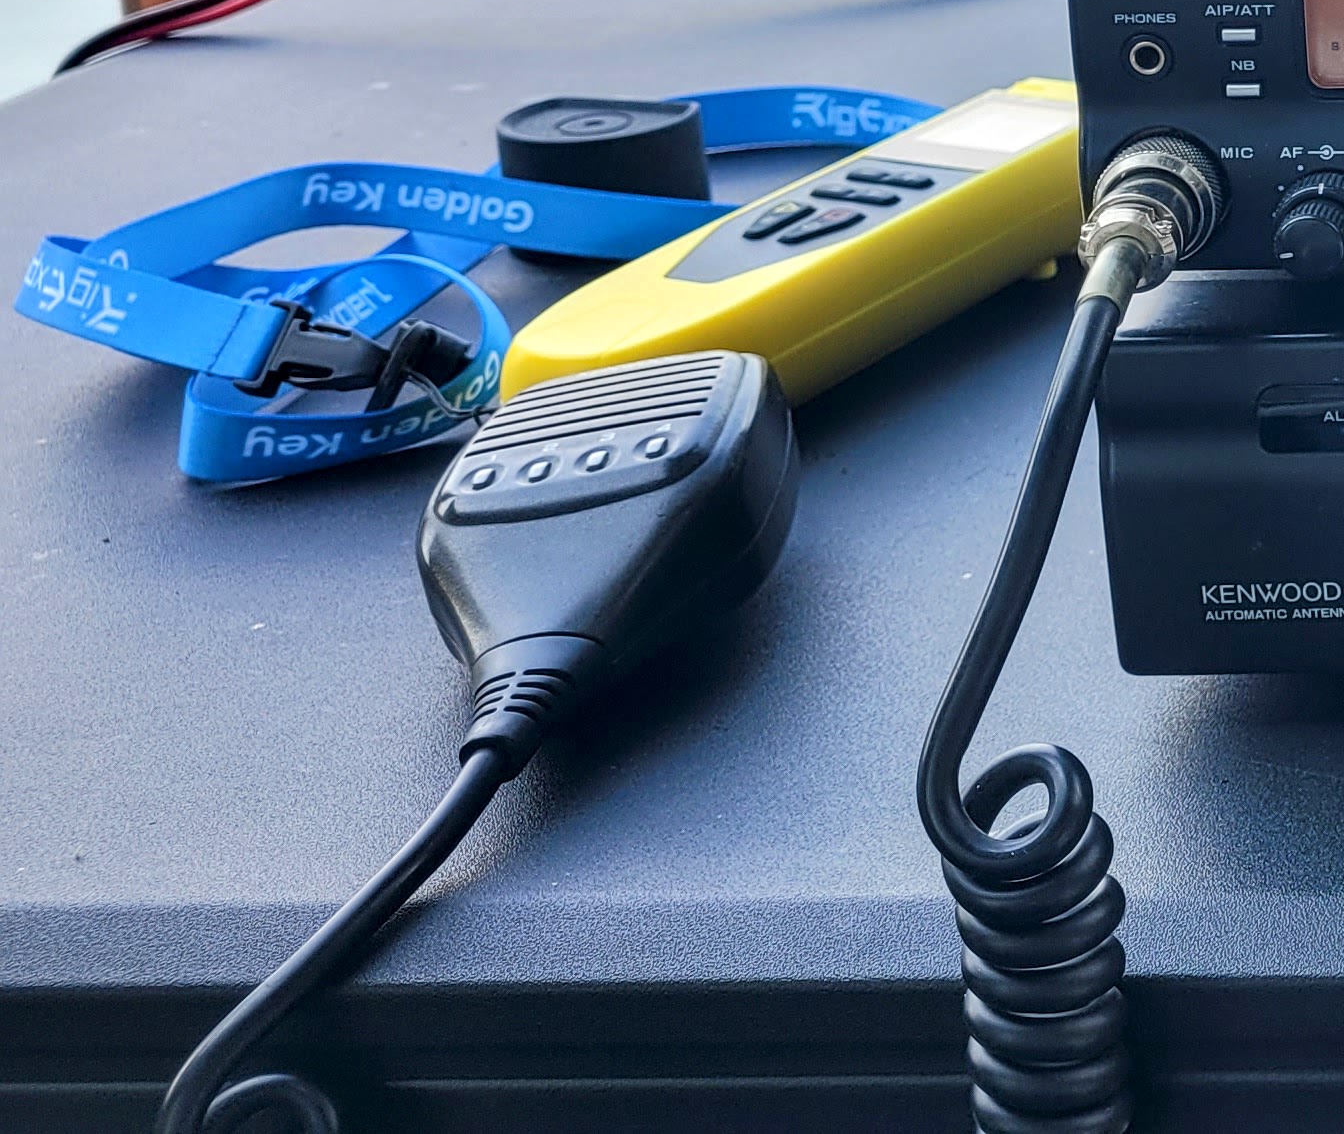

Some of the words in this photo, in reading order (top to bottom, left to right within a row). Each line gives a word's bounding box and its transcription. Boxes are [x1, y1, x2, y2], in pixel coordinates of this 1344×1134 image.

[1204, 4, 1276, 17] AIP/ATT
[1114, 13, 1177, 24] PHONES
[1231, 59, 1256, 72] NB
[792, 92, 920, 136] RigEx
[1220, 147, 1254, 160] MIC
[1279, 146, 1304, 160] AF
[302, 172, 385, 212] Key
[397, 183, 535, 234] Golden
[241, 424, 344, 460] Key
[1200, 581, 1343, 605] KENWOOD
[1204, 607, 1288, 622] AUTOMATIC
